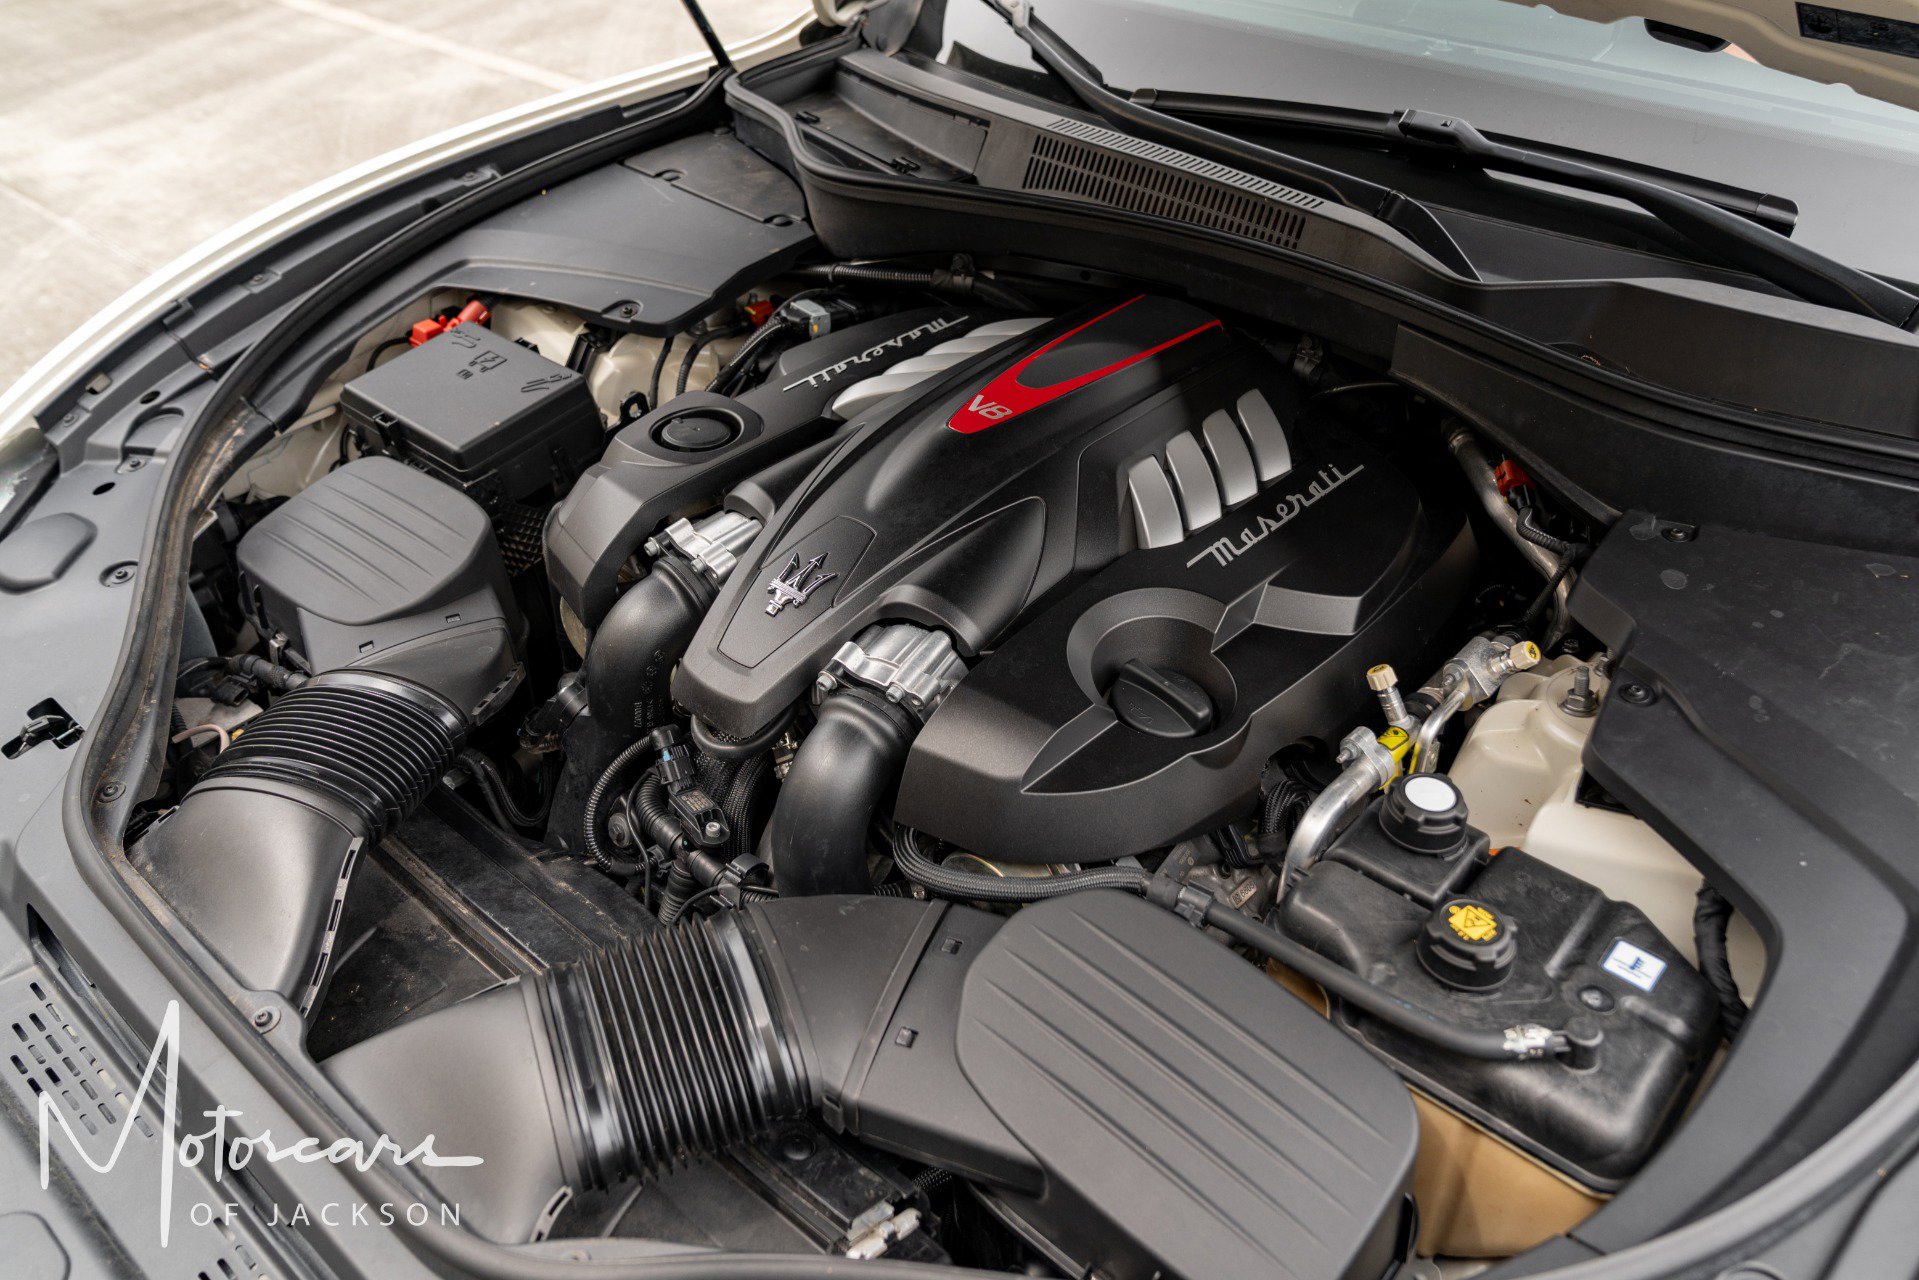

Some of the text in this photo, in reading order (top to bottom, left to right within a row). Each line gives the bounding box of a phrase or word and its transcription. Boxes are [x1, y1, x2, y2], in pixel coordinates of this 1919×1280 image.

[783, 315, 969, 391] Maserati
[968, 394, 1013, 420] V8
[1186, 463, 1365, 568] Maserati
